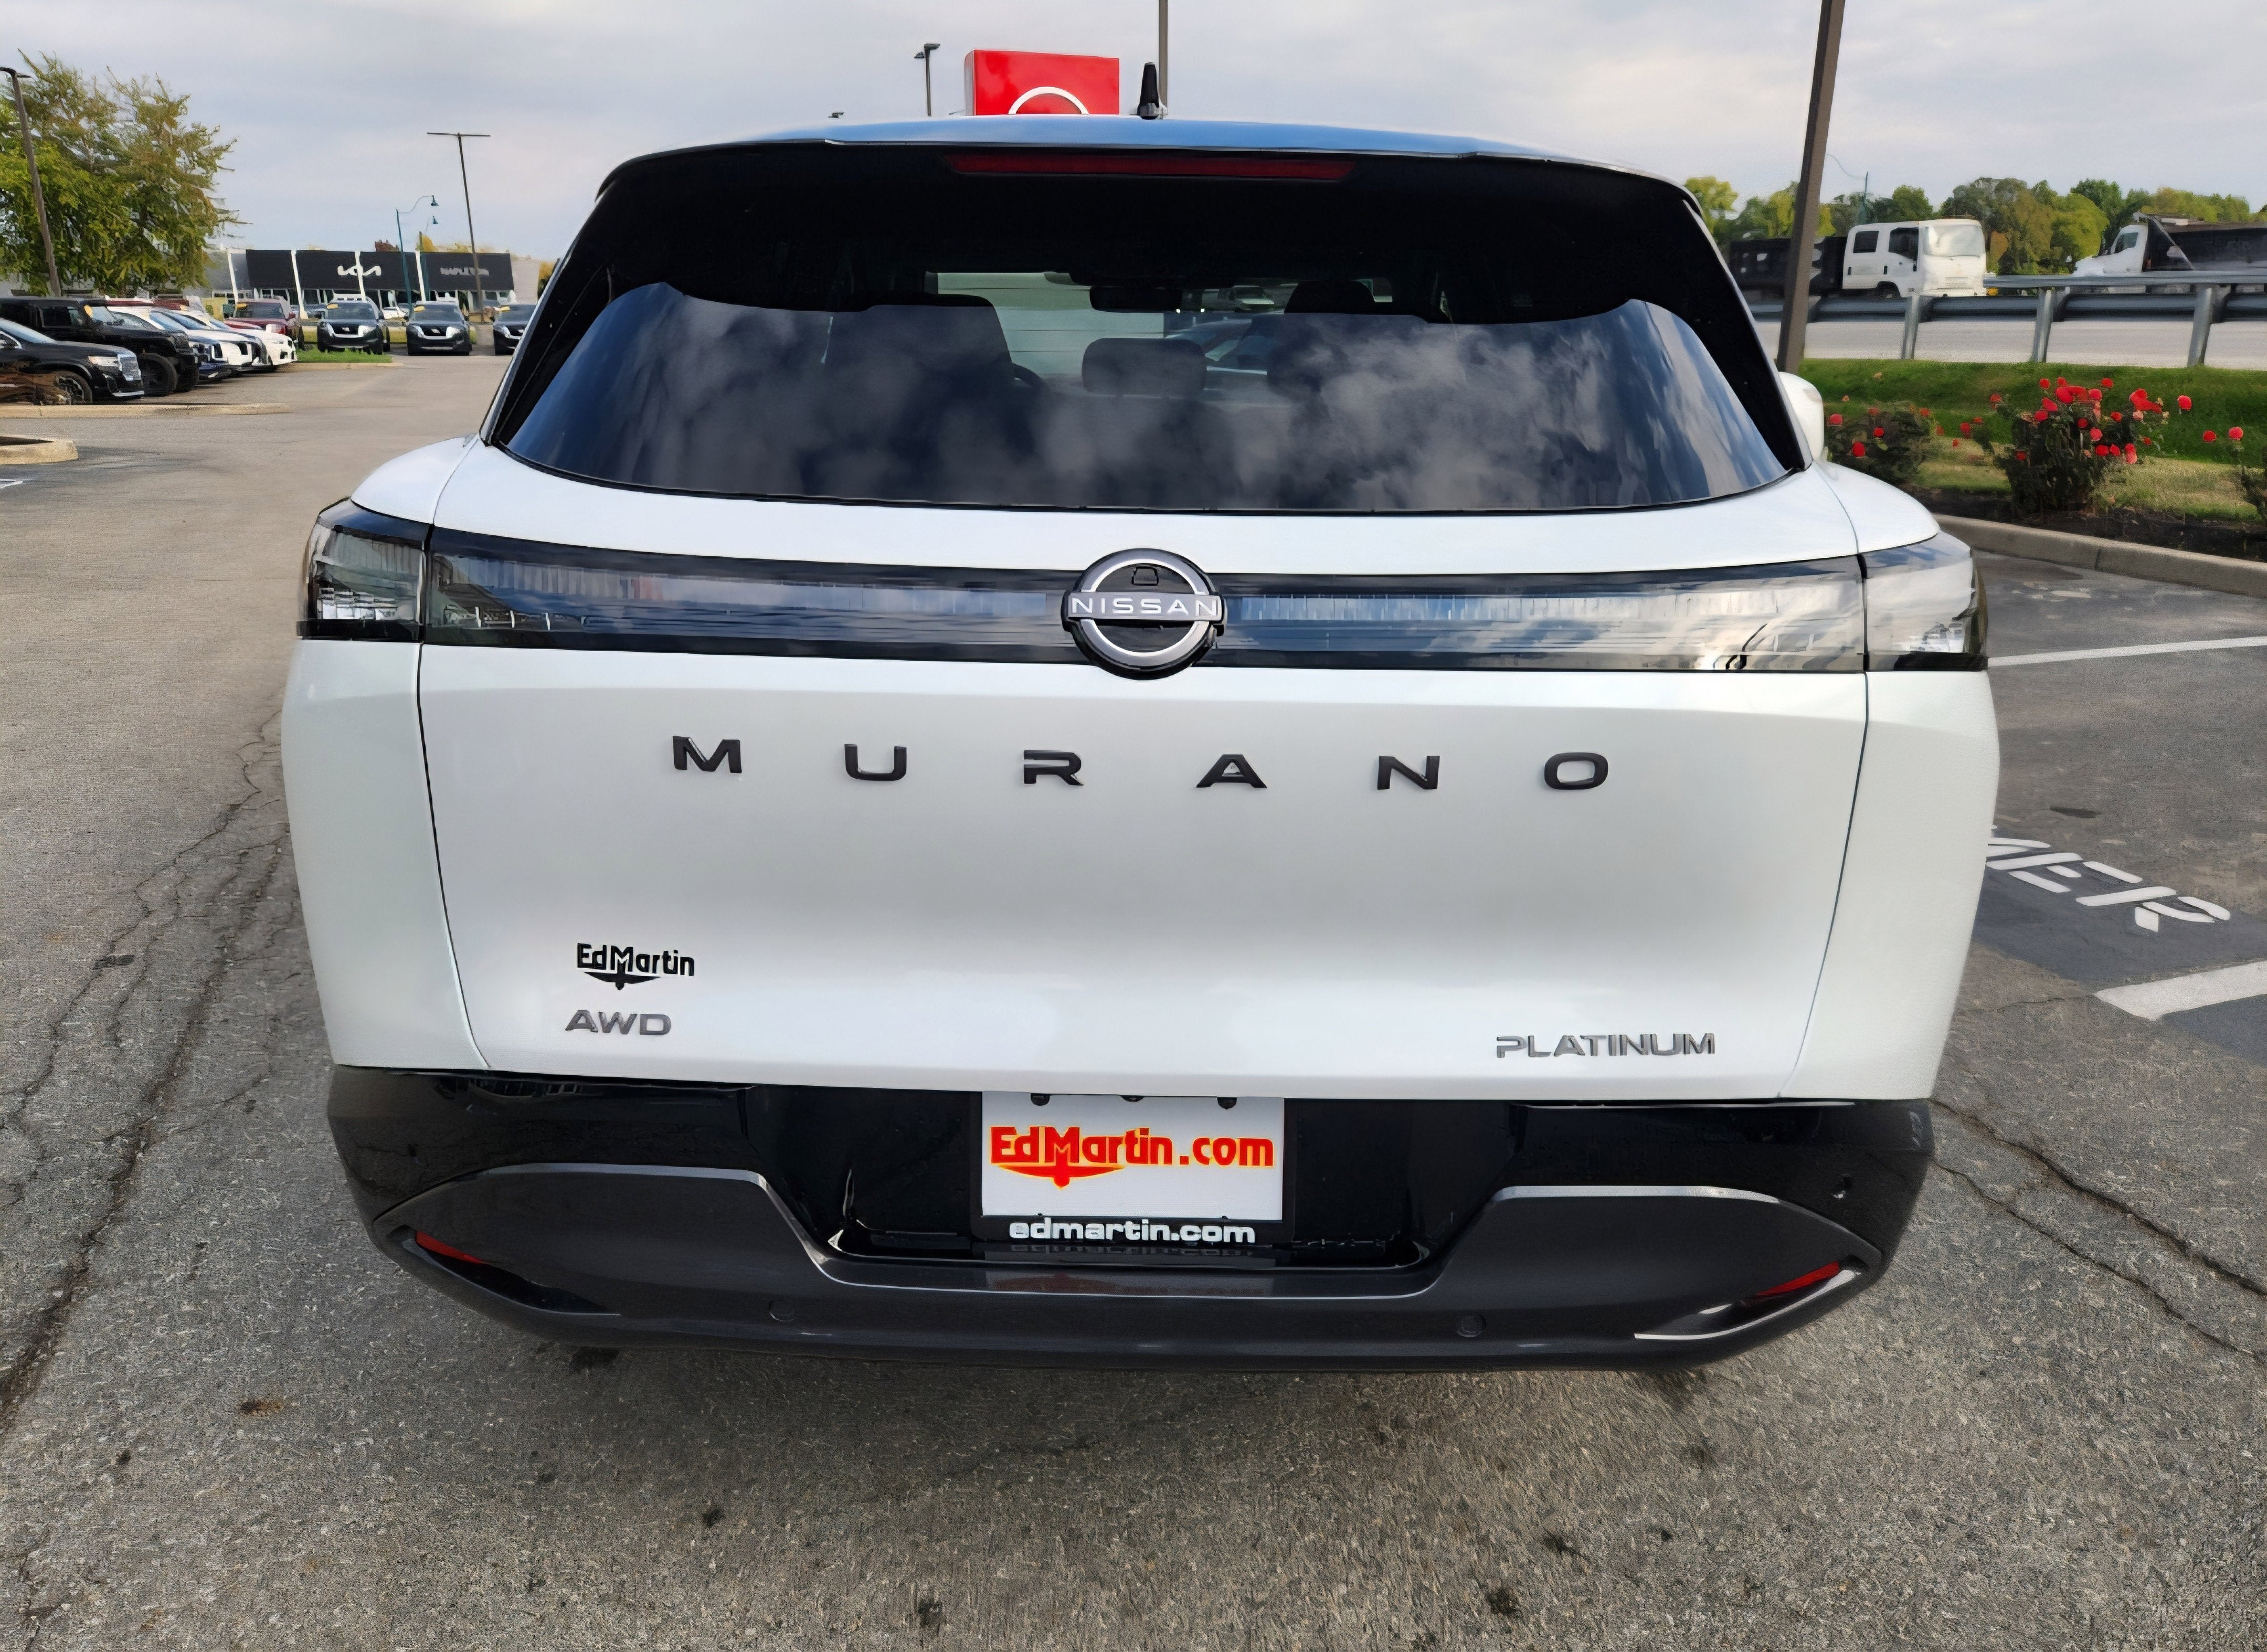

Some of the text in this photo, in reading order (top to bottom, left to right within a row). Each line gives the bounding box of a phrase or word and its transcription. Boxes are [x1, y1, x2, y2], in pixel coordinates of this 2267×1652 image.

[1072, 597, 1218, 617] NISSAN
[672, 735, 1608, 790] MURANO
[565, 1010, 671, 1035] AWD
[1496, 1033, 1715, 1058] PLATINUM
[1009, 1217, 1256, 1243] edmartin.com
